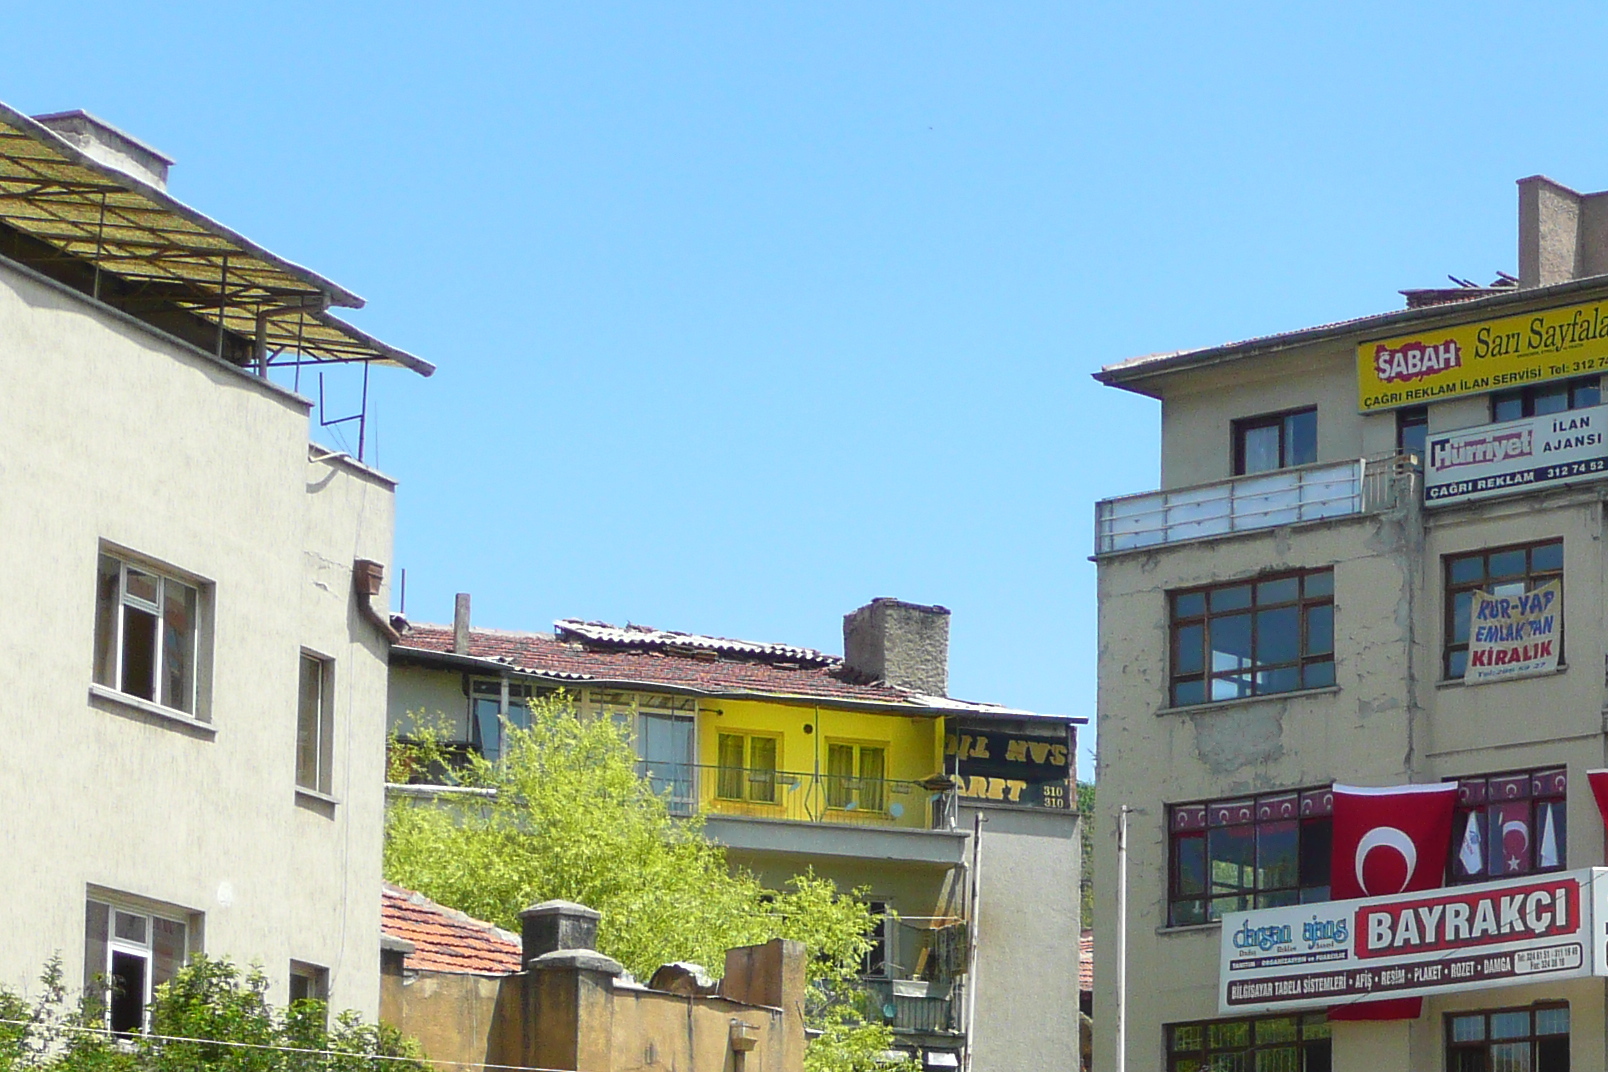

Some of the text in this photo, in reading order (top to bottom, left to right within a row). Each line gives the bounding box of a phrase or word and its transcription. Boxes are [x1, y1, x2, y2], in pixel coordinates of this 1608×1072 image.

[1364, 391, 1402, 409] ÇAĞRI
[1406, 382, 1456, 400] REKLAM
[1460, 374, 1489, 392] İLAN
[1492, 364, 1542, 386] SERVİSİ
[1573, 358, 1594, 371] 312
[1553, 416, 1590, 433] İLAN
[1543, 433, 1602, 453] AJANSI
[1430, 482, 1472, 500] ÇAĞRI
[1477, 471, 1535, 490] REKLAM
[1547, 466, 1569, 478] 312
[1572, 464, 1586, 474] 74
[1477, 590, 1555, 620] KUR-YAP
[1471, 640, 1553, 667] KİRALIK
[1043, 785, 1063, 797] 310
[1044, 798, 1064, 808] 310
[1367, 888, 1567, 951] BAYRAKÇI
[1231, 980, 1273, 1000] BİLGİSAYAR
[1274, 979, 1302, 996] TABELA
[1303, 971, 1347, 993] SİSTEMLERİ
[1355, 970, 1373, 991] AFİŞ
[1414, 964, 1442, 982] PLAKET
[1450, 961, 1475, 978] ROZET
[1483, 956, 1511, 974] DAMGA
